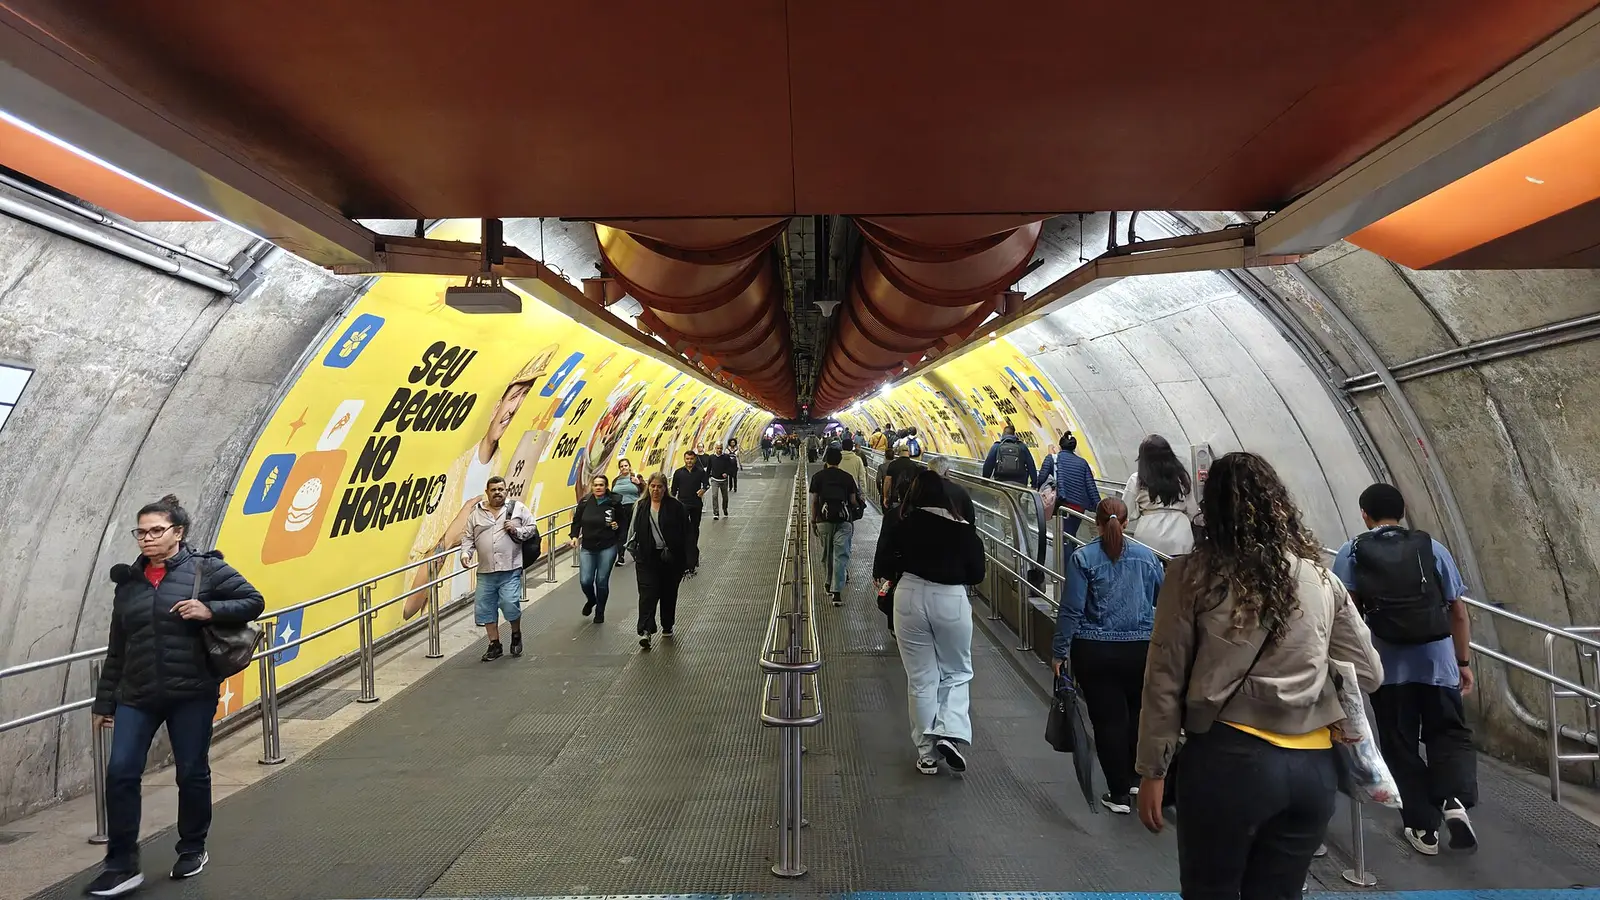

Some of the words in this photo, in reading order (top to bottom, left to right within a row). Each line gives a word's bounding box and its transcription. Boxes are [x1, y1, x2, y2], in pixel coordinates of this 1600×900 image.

[568, 397, 593, 425] 99
[551, 430, 583, 459] Food
[348, 435, 401, 484] NO
[512, 459, 526, 477] 99
[329, 473, 447, 538] HORÁRIO
